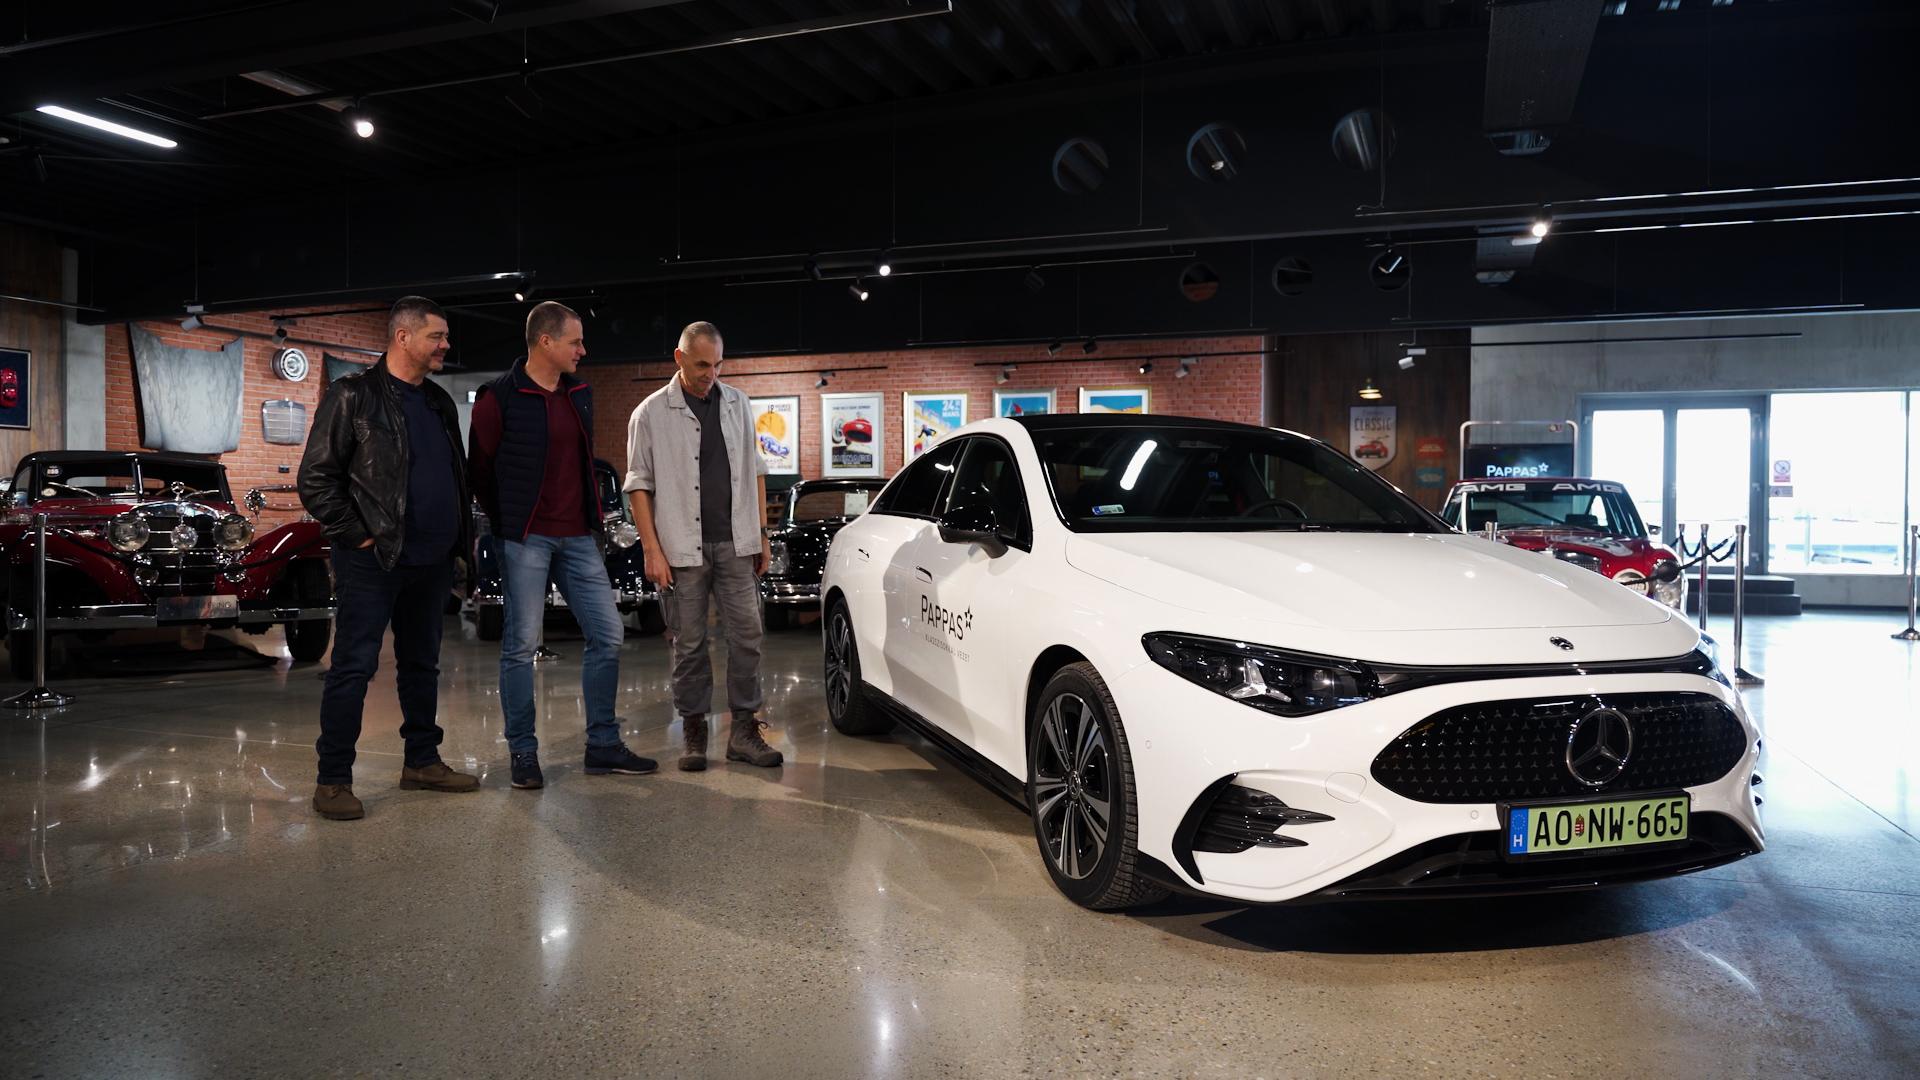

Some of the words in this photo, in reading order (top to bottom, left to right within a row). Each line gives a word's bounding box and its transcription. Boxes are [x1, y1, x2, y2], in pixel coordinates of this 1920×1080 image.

[1354, 416, 1392, 431] CLASSIC
[1486, 465, 1538, 477] PAPPAS
[1457, 483, 1527, 493] AMG
[1552, 483, 1623, 493] AMG
[921, 594, 964, 640] PAPPAS
[1513, 834, 1523, 847] H
